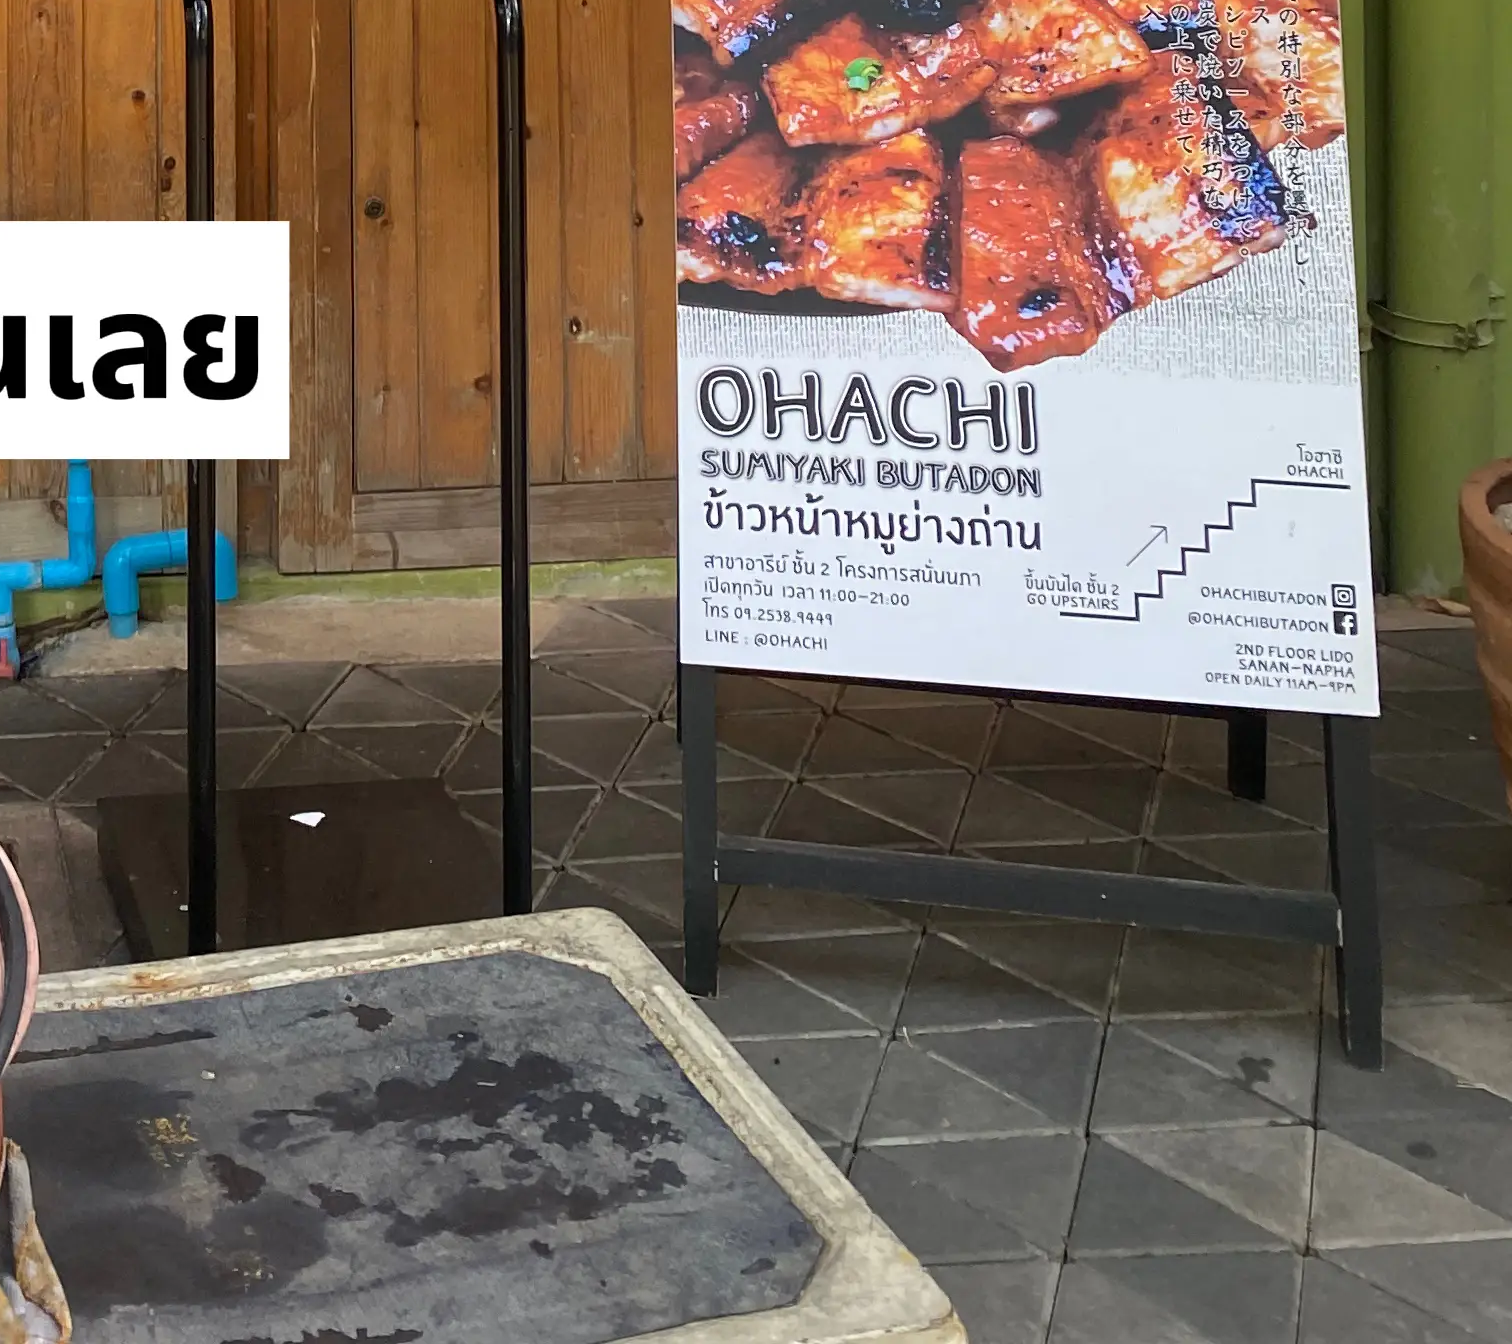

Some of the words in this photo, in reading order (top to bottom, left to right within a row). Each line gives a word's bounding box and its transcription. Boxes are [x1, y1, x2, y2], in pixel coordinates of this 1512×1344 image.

[696, 365, 1038, 454] OHACHI
[1296, 443, 1343, 464] โอฮาชิ
[700, 449, 866, 487] SUMIYAKI
[876, 460, 1042, 497] BUTADON
[1287, 464, 1345, 480] OHACHI
[703, 486, 1042, 556] ข้าวหน้าหมูย่างถ่าน
[704, 554, 790, 576] สาขาอารีย์
[792, 550, 815, 576] ชั้น
[820, 562, 830, 577] 2
[704, 578, 773, 600] เปิดทุกวัน
[782, 585, 816, 601] เวลา
[1024, 569, 1082, 593] ขึ้นบันได
[1087, 572, 1108, 594] ชั้น
[1111, 584, 1120, 596] 2
[1027, 593, 1047, 606] GO
[1051, 595, 1120, 610] UPSTAIRS
[1200, 586, 1327, 606] OHACHIBUTADON
[702, 597, 729, 619] โทร
[734, 606, 834, 626] 09.2538.9449
[1188, 612, 1329, 633] @OHACHIBUTADON
[705, 630, 739, 644] LINE
[754, 633, 829, 650] @OHACHI
[1235, 644, 1264, 657] 2ND
[1268, 646, 1316, 660] FLOOR
[1321, 648, 1354, 663] LIDO
[1205, 672, 1240, 686] OPEN
[1245, 674, 1282, 688] DAILY
